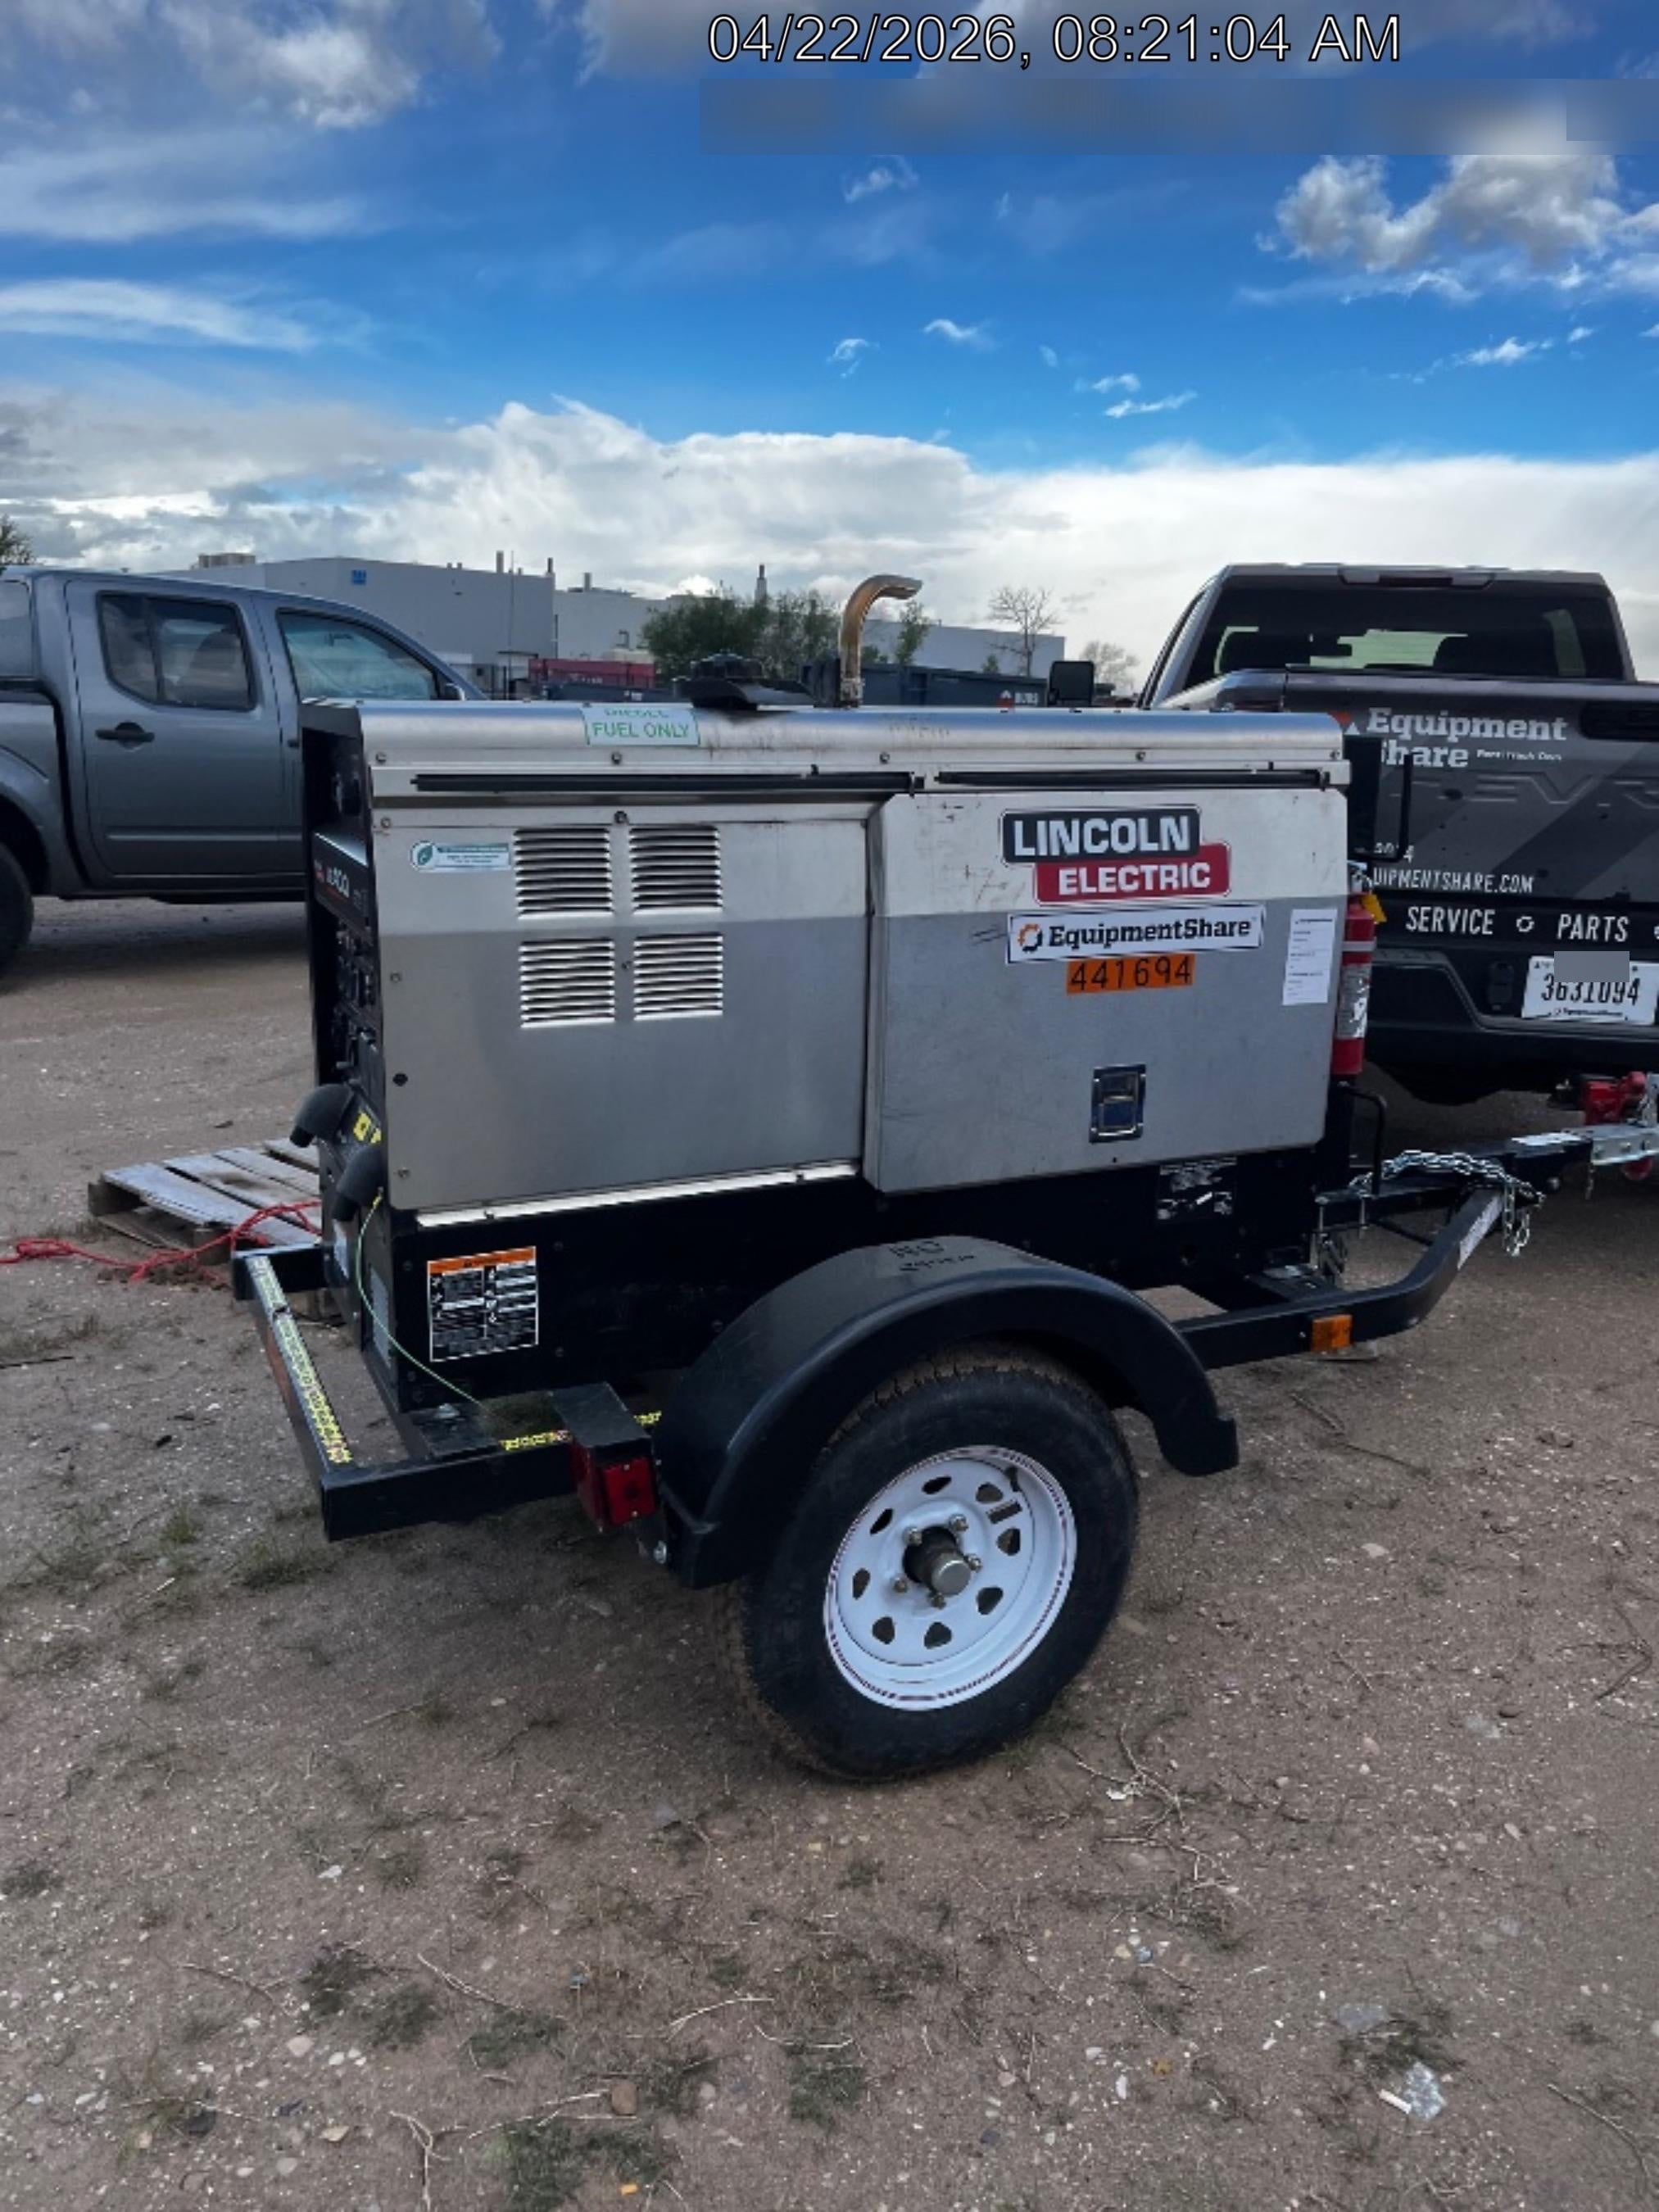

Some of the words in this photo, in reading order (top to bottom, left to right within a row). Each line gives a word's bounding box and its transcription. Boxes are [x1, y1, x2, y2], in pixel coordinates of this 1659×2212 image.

[592, 721, 640, 738] FUEL
[643, 721, 689, 738] ONLY
[1366, 707, 1569, 743] Equipment
[1380, 739, 1469, 768] hare
[1013, 815, 1190, 856] LINCOLN
[1058, 863, 1212, 895] ELECTRIC
[1373, 867, 1535, 894] UIPMENTSHARE.COM
[1048, 918, 1253, 950] EquipmentShare
[1405, 905, 1495, 936] SERVICE
[1557, 913, 1630, 942] PARTS
[1070, 956, 1192, 991] 441694
